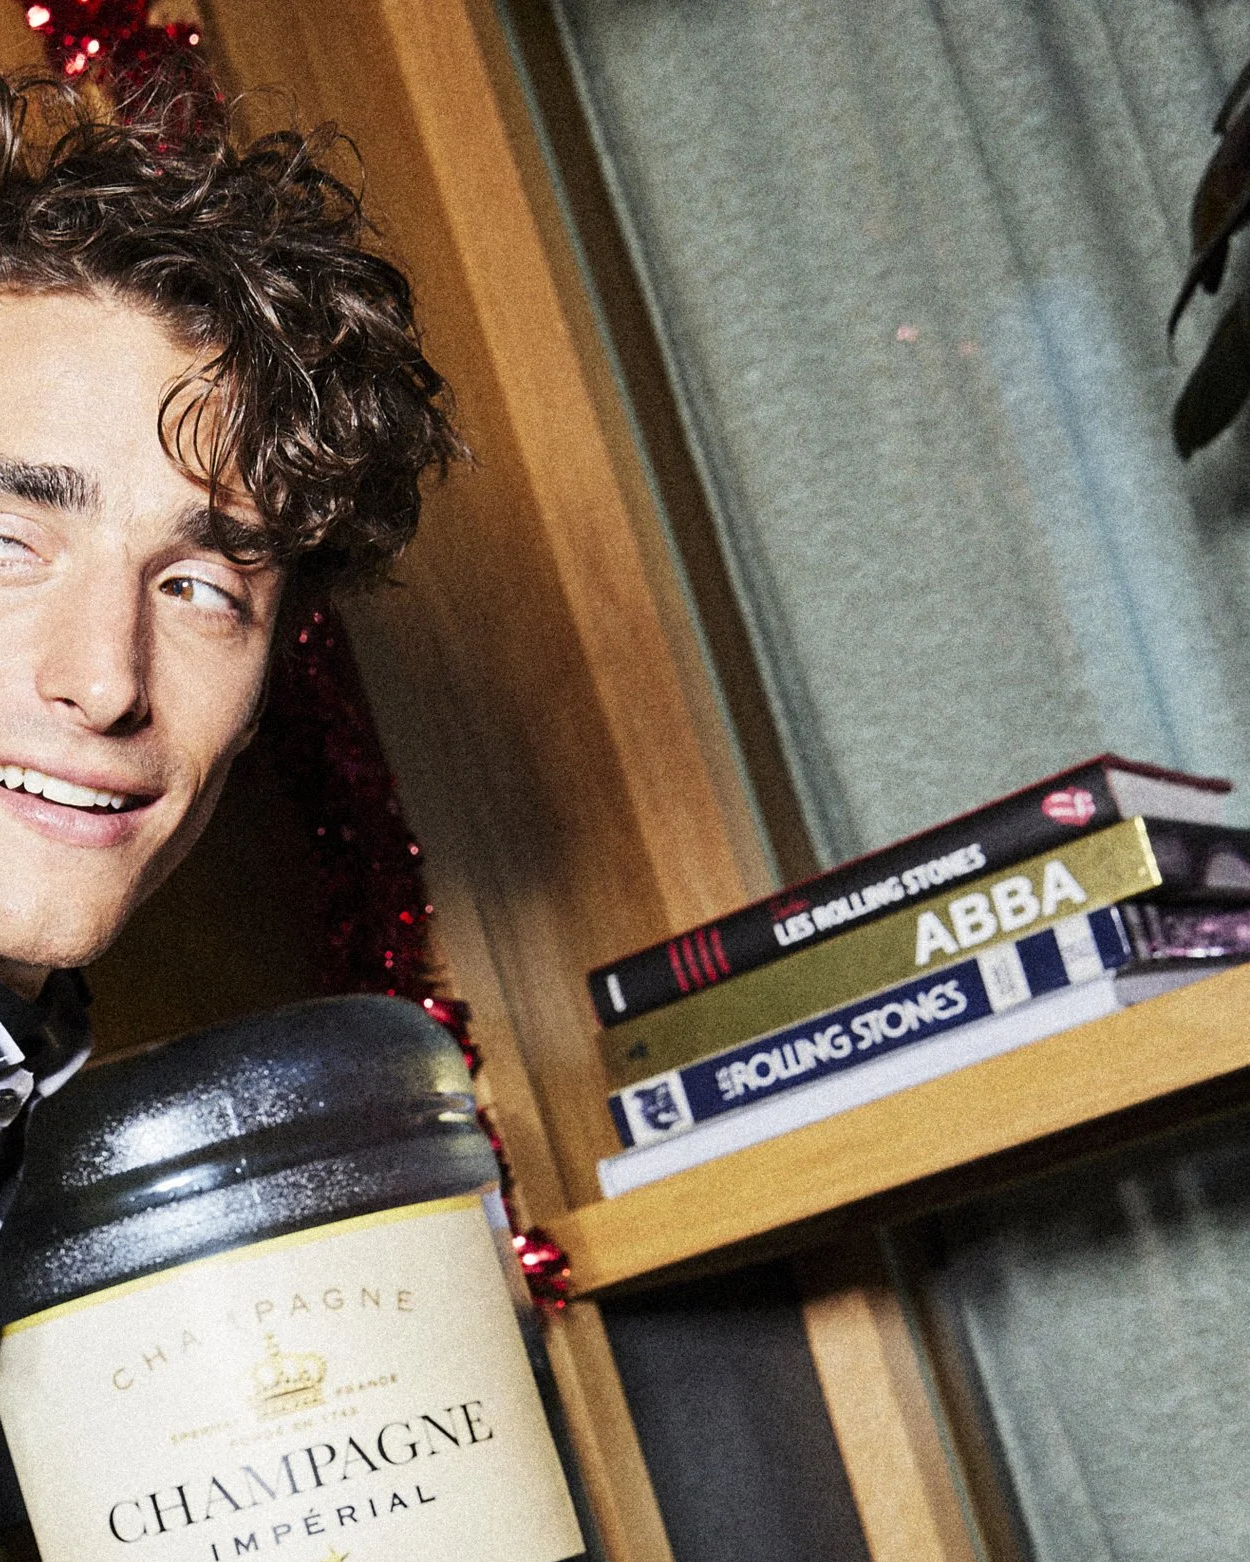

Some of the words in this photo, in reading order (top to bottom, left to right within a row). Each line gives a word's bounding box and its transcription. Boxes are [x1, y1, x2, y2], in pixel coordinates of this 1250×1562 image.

[773, 911, 816, 946] LES
[811, 876, 905, 931] ROLLING
[901, 843, 986, 895] STONES
[914, 859, 1087, 965] ABBA
[727, 1023, 852, 1097] ROLLING
[851, 979, 968, 1050] STONES
[108, 1400, 493, 1545] CHAMPAGNE
[210, 1484, 436, 1562] IMPÉRIAL
